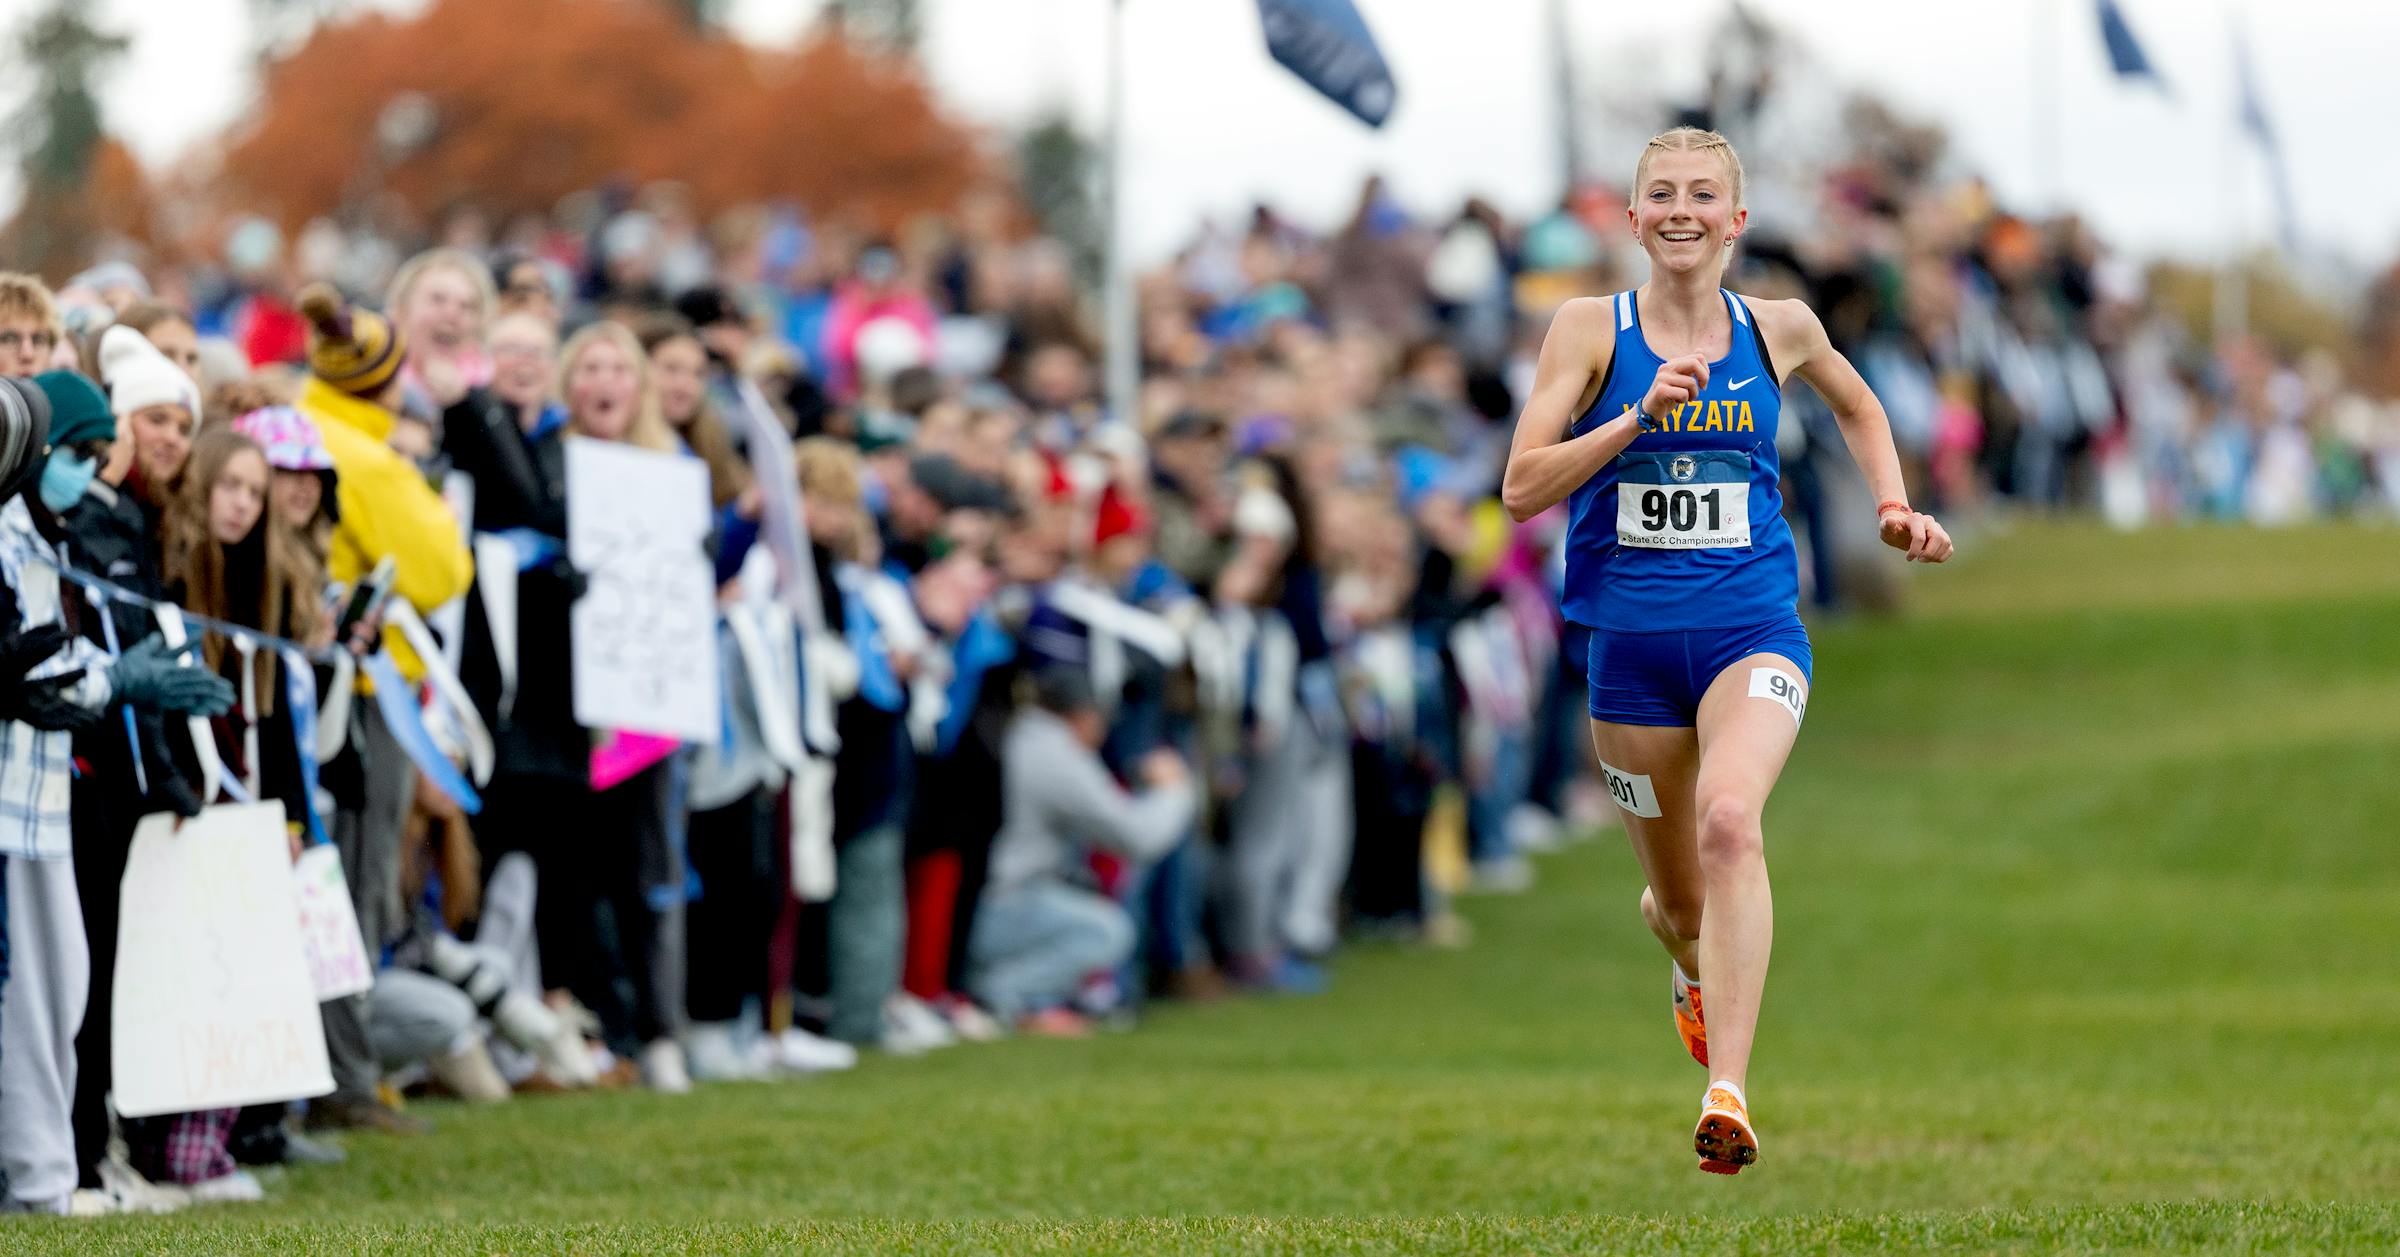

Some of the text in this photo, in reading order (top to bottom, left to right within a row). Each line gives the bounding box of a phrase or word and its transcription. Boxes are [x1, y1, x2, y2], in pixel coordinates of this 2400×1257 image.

[1623, 400, 1754, 432] YZATA
[1641, 488, 1720, 532] 901
[1627, 535, 1739, 546] State CC Championships
